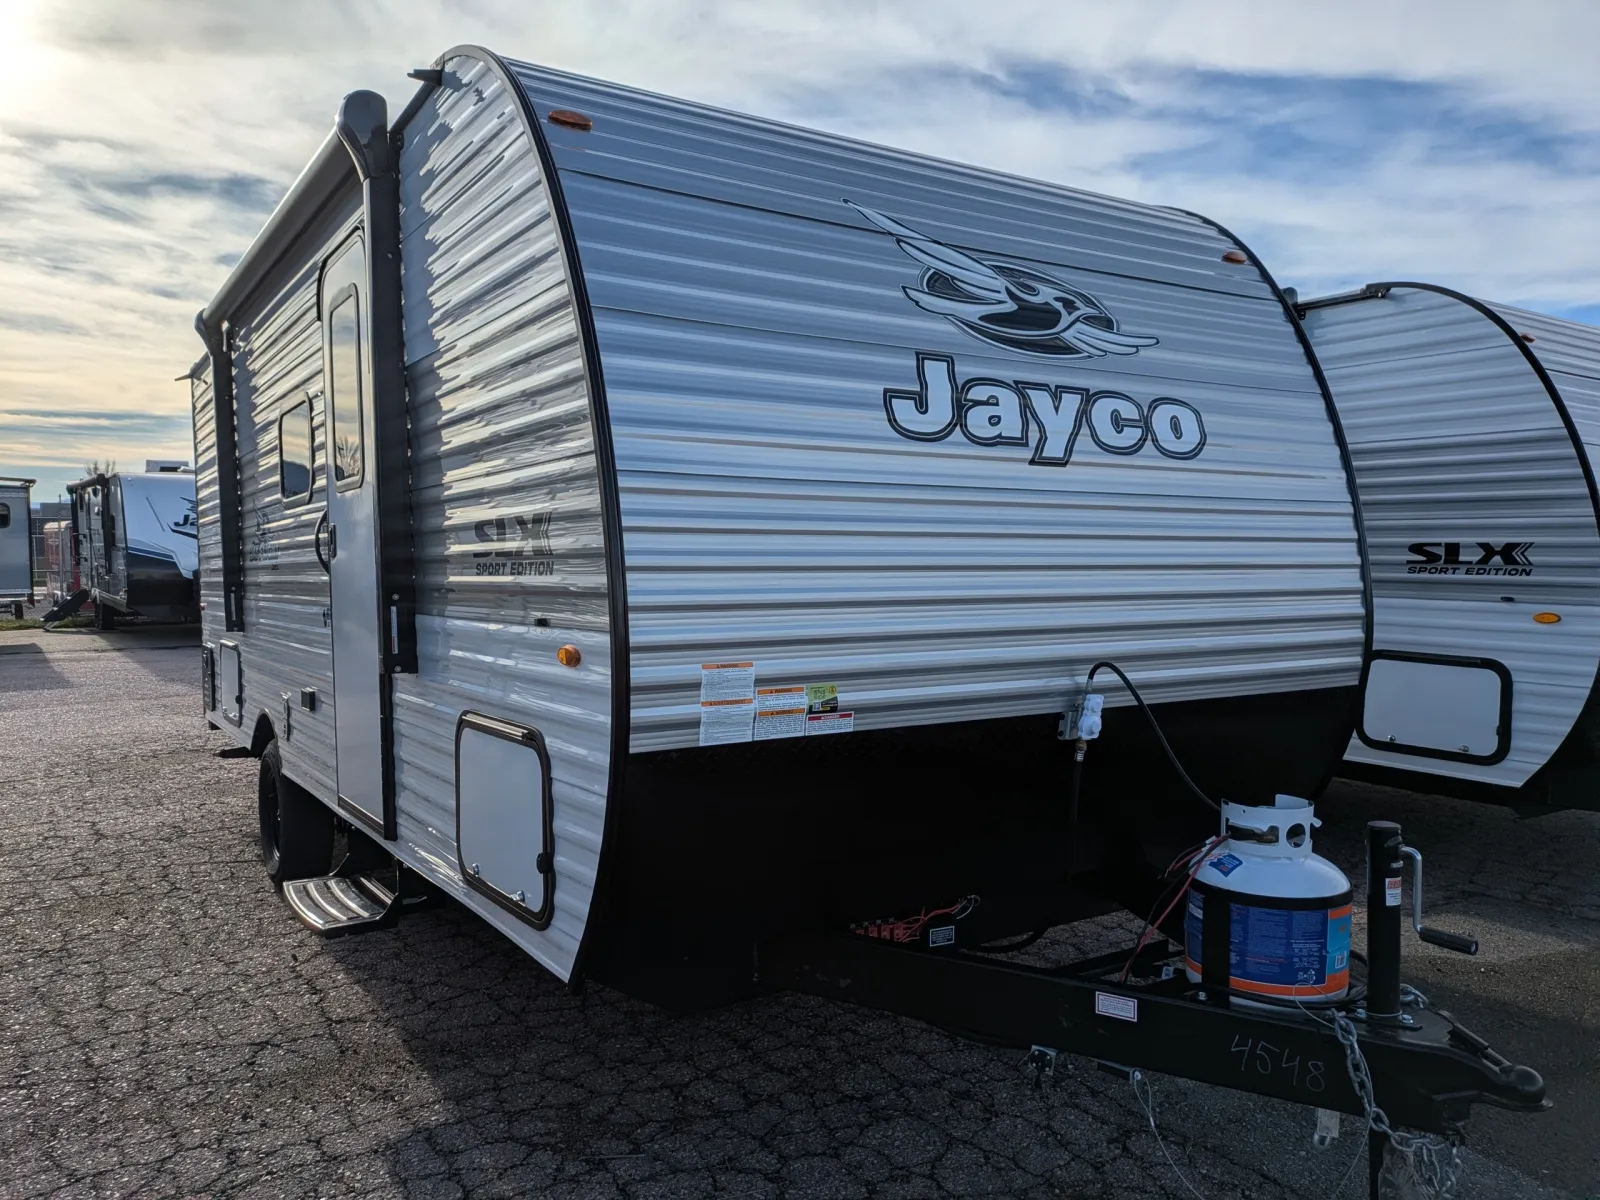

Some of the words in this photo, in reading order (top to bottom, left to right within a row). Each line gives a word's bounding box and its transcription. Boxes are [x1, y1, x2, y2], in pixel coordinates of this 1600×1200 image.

[883, 351, 1207, 467] Jayco
[473, 512, 554, 558] SLX
[475, 562, 507, 576] SPORT
[510, 561, 554, 576] EDITION
[1406, 542, 1535, 566] SLX
[1407, 566, 1460, 575] SPORT
[1465, 567, 1533, 577] EDITION
[1231, 1034, 1325, 1092] 4548
